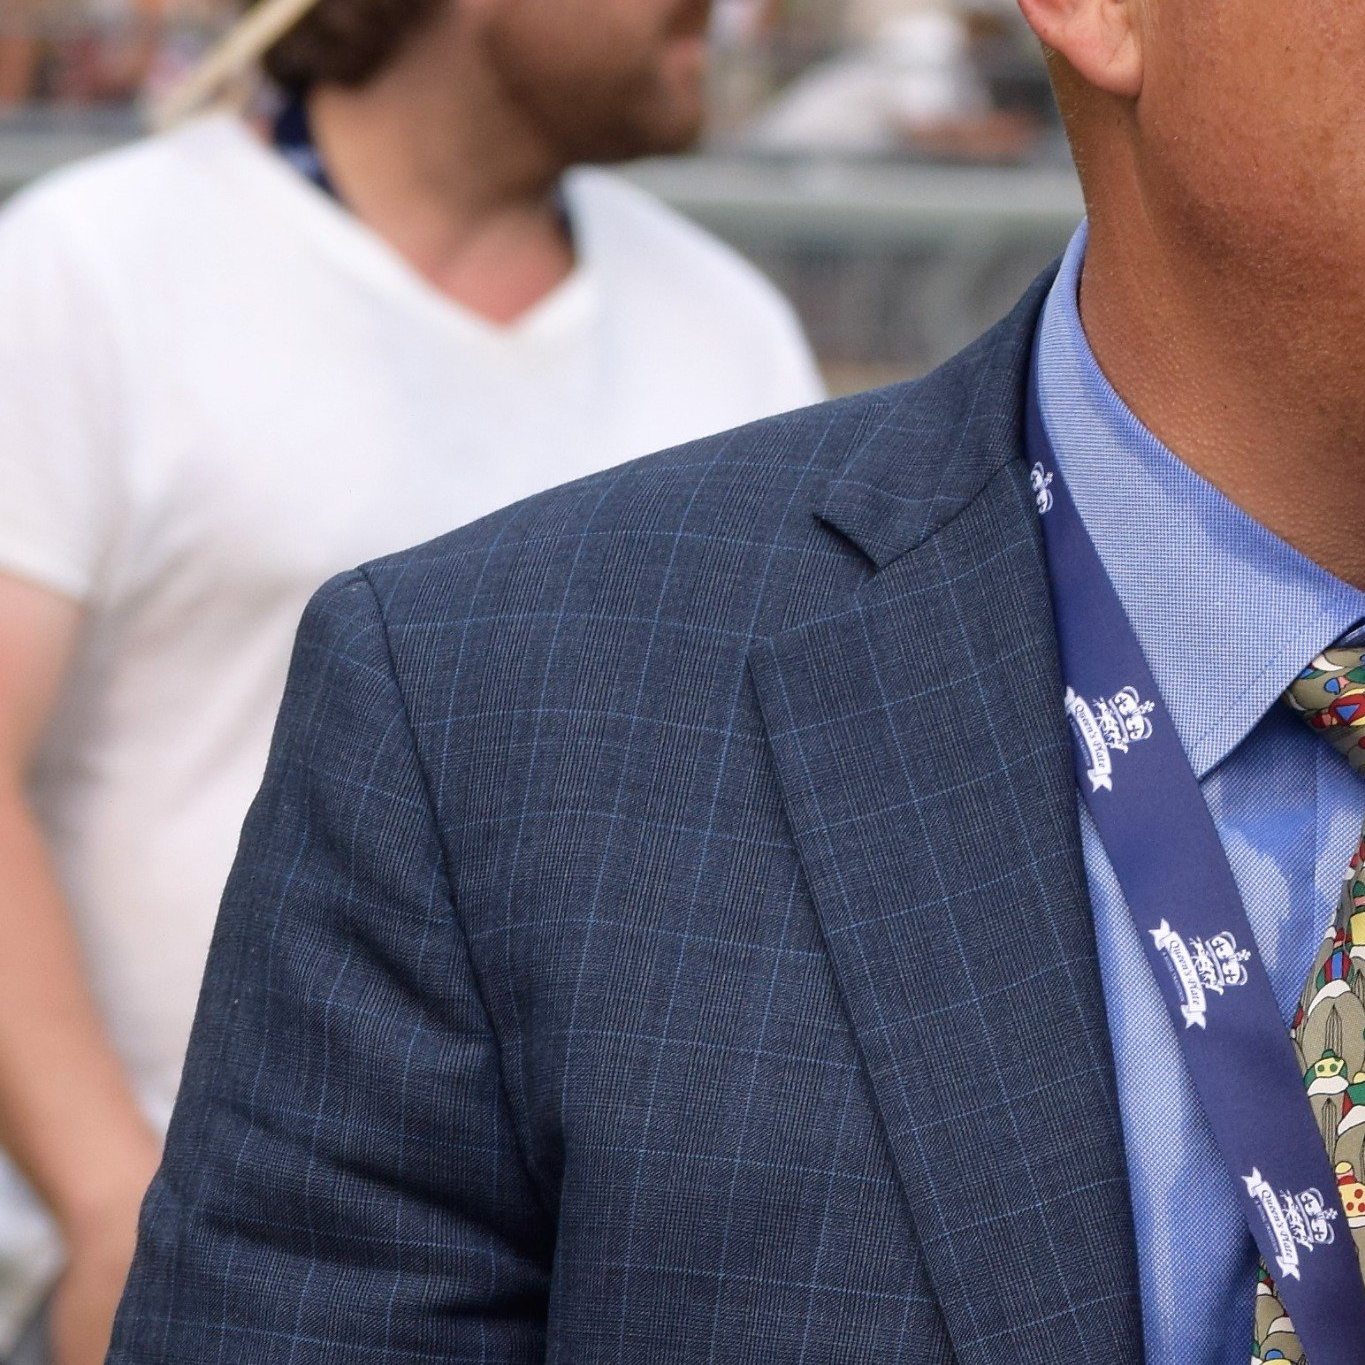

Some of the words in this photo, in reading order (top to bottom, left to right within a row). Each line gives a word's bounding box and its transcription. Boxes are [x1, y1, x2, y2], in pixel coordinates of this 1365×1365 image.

[1074, 703, 1098, 739] Queen's
[1092, 739, 1106, 768] Plate
[1169, 939, 1193, 977] Queen's
[1187, 977, 1201, 1005] Plate
[1261, 1189, 1285, 1228] Queen's
[1279, 1230, 1293, 1259] Plate
